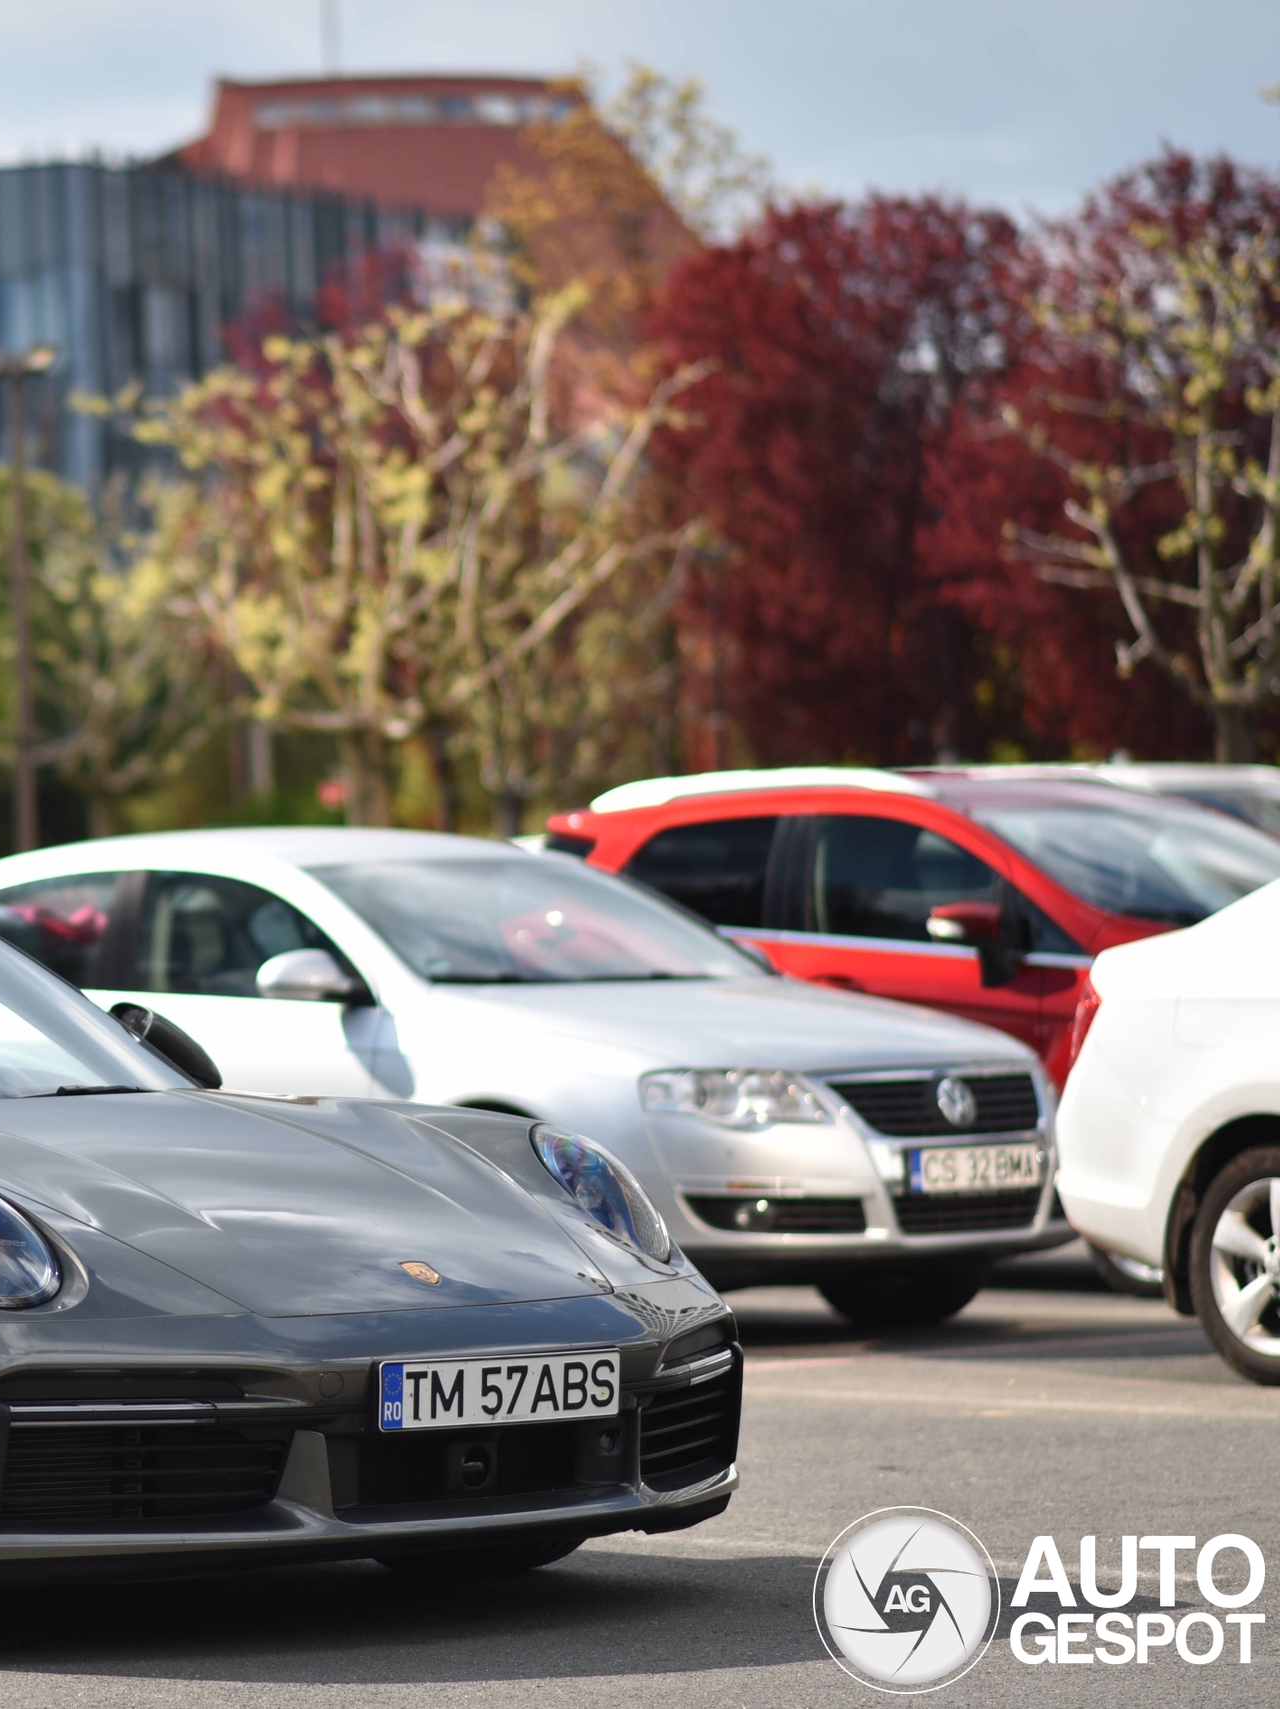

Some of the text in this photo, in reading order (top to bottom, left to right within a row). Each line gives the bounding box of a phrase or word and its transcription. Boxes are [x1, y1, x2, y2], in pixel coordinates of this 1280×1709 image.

[925, 1152, 957, 1184] CS
[405, 1358, 615, 1420] TM 57ABS
[384, 1401, 402, 1421] RO
